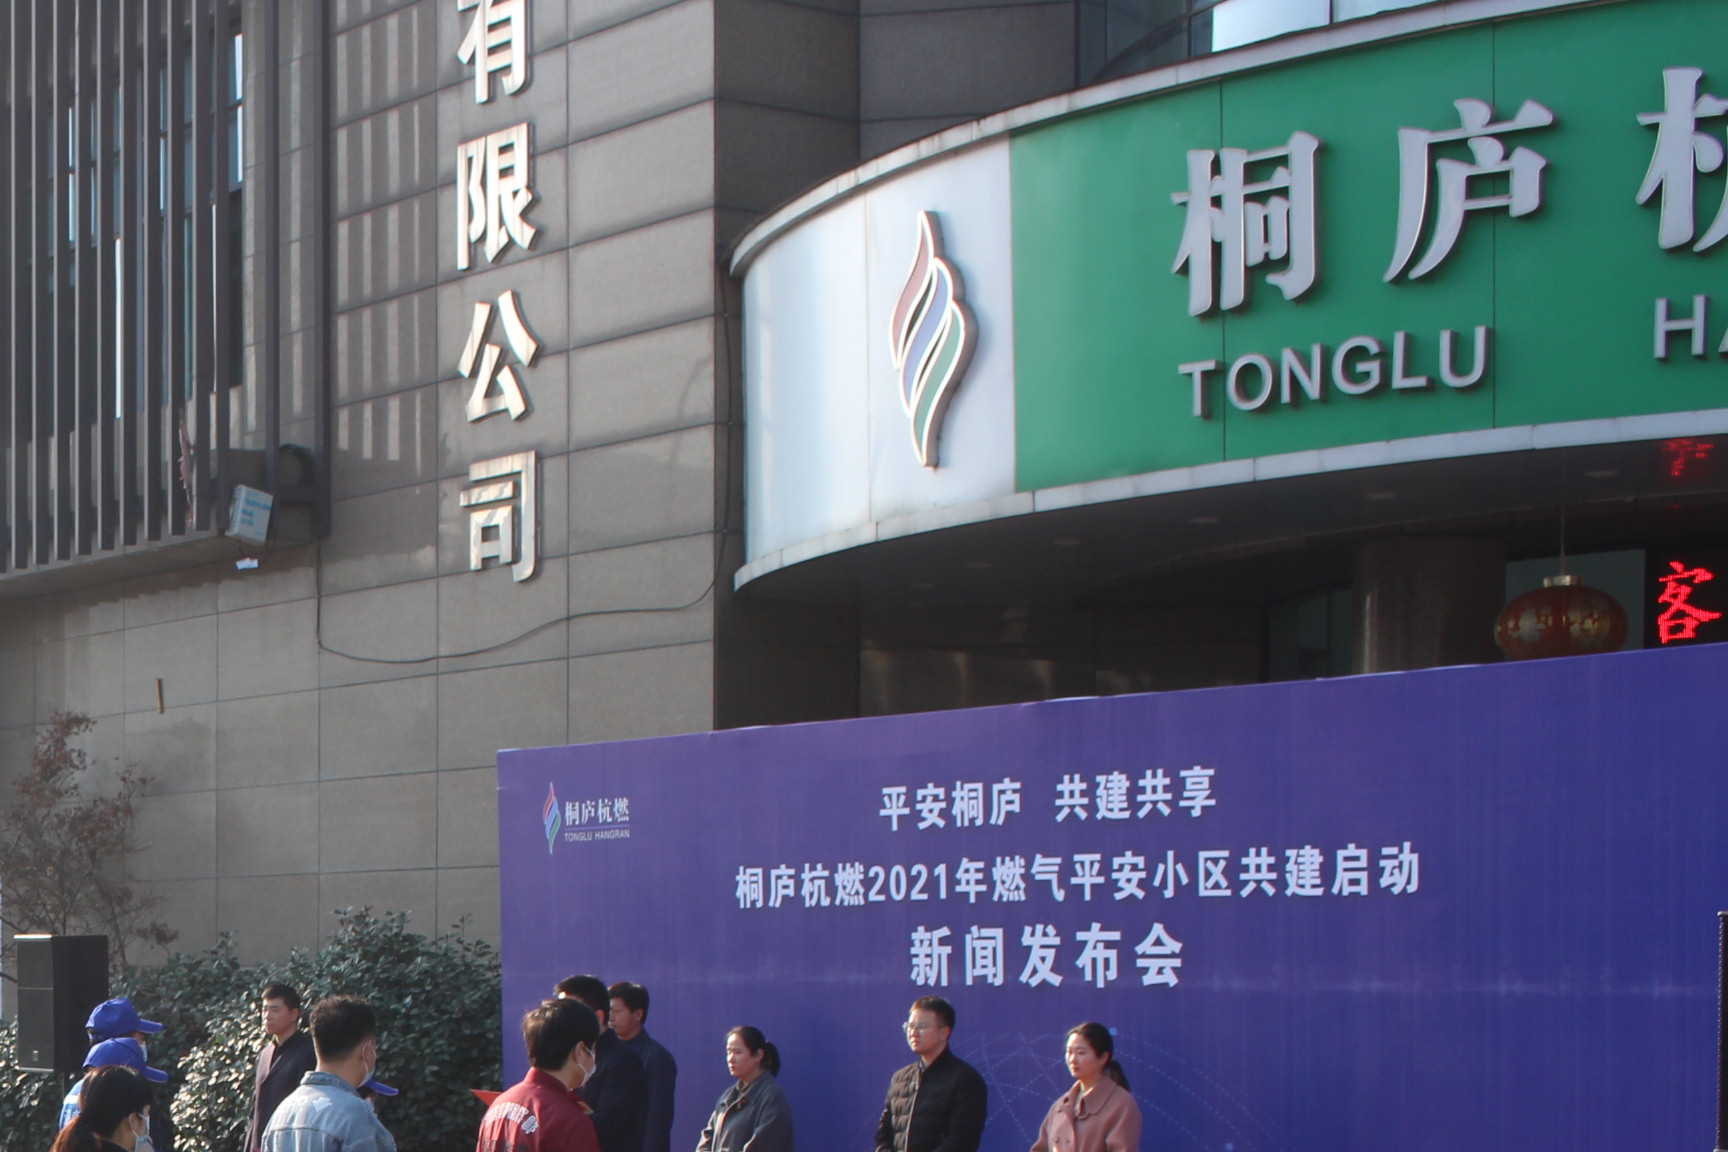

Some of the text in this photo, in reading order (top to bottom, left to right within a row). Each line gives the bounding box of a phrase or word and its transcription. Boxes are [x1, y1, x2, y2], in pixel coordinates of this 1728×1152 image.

[456, 0, 540, 583] 有限公司
[1178, 325, 1491, 418] TONGLU
[1658, 560, 1722, 645] 客
[564, 797, 631, 826] 桐庐杭燃
[879, 766, 1217, 831] 平安桐庐 共建共享
[564, 829, 630, 842] TONGLU HANGRAN
[735, 841, 1420, 909] 桐庐杭燃2021年燃气平安小区共建启动
[909, 921, 1184, 989] 新闻发布会
